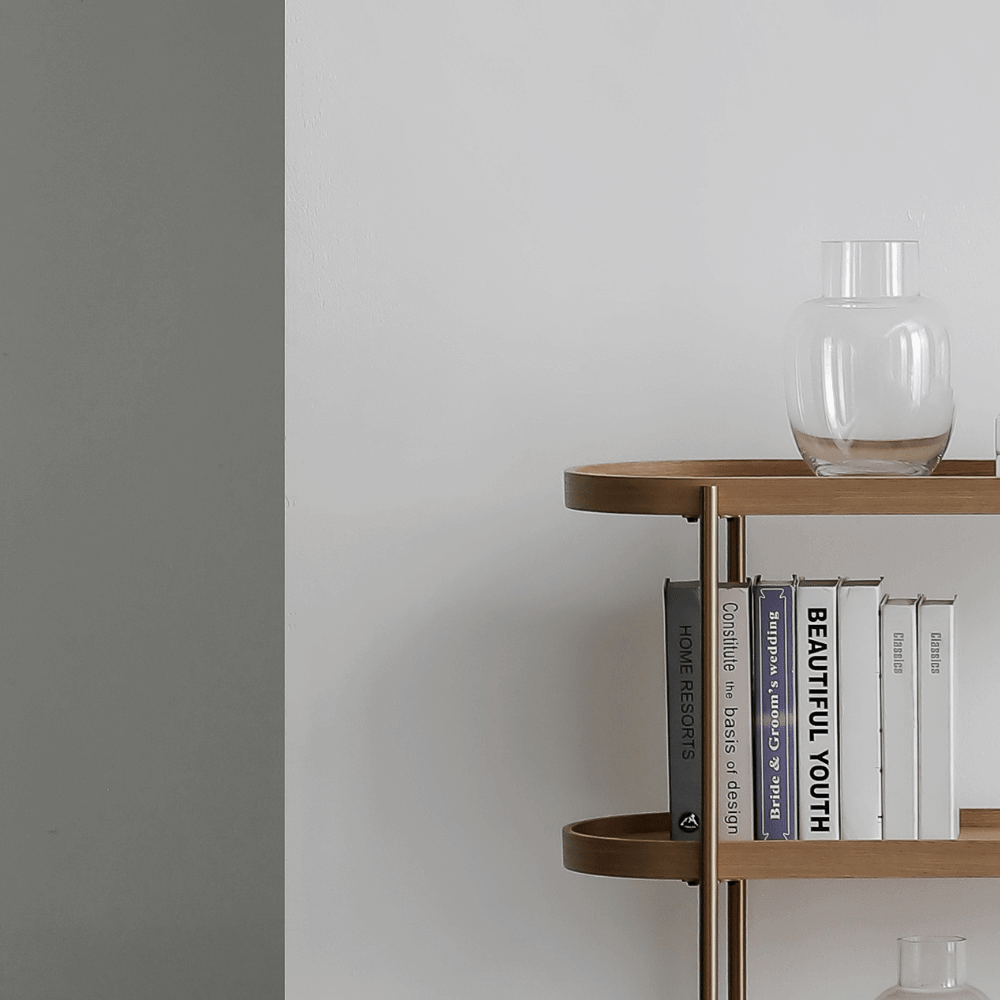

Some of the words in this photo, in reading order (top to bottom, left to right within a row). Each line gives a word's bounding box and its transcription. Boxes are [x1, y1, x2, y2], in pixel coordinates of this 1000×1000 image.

[678, 624, 693, 675] HOME
[722, 602, 739, 672] Constitute
[765, 610, 781, 676] wedding
[892, 631, 905, 675] Classics
[929, 631, 942, 675] Classics
[725, 680, 735, 700] the
[807, 607, 829, 742] BEAUTIFUL
[680, 680, 696, 761] RESORTS
[724, 708, 739, 753] basis
[767, 680, 780, 752] Groom's
[726, 760, 738, 776] of
[768, 757, 781, 772] &
[723, 780, 740, 835] design
[768, 775, 782, 821] Bride
[809, 749, 830, 832] YOUTH
